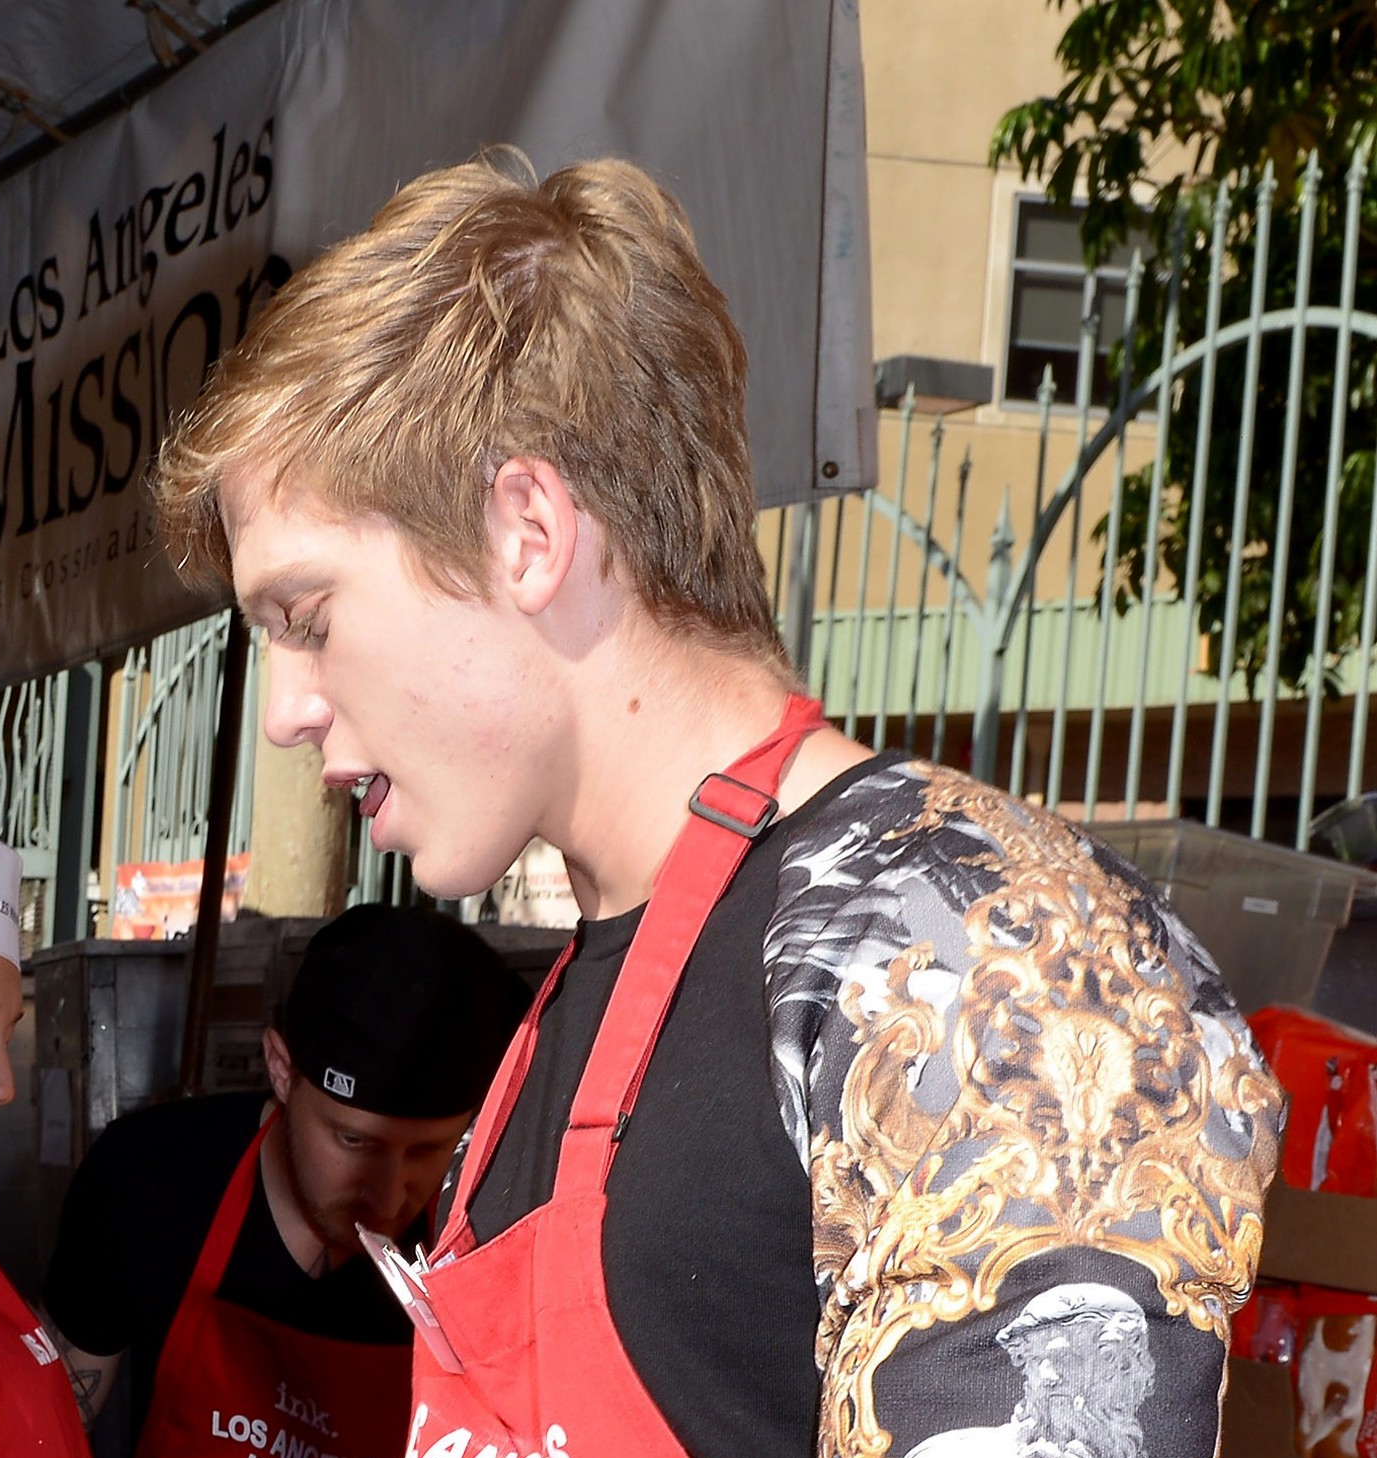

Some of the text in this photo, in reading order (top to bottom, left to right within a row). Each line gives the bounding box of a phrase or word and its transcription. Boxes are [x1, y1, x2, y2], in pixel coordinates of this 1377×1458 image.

[77, 117, 275, 321] Angeles
[20, 511, 153, 599] Cossrads
[212, 1410, 269, 1450] LOS
